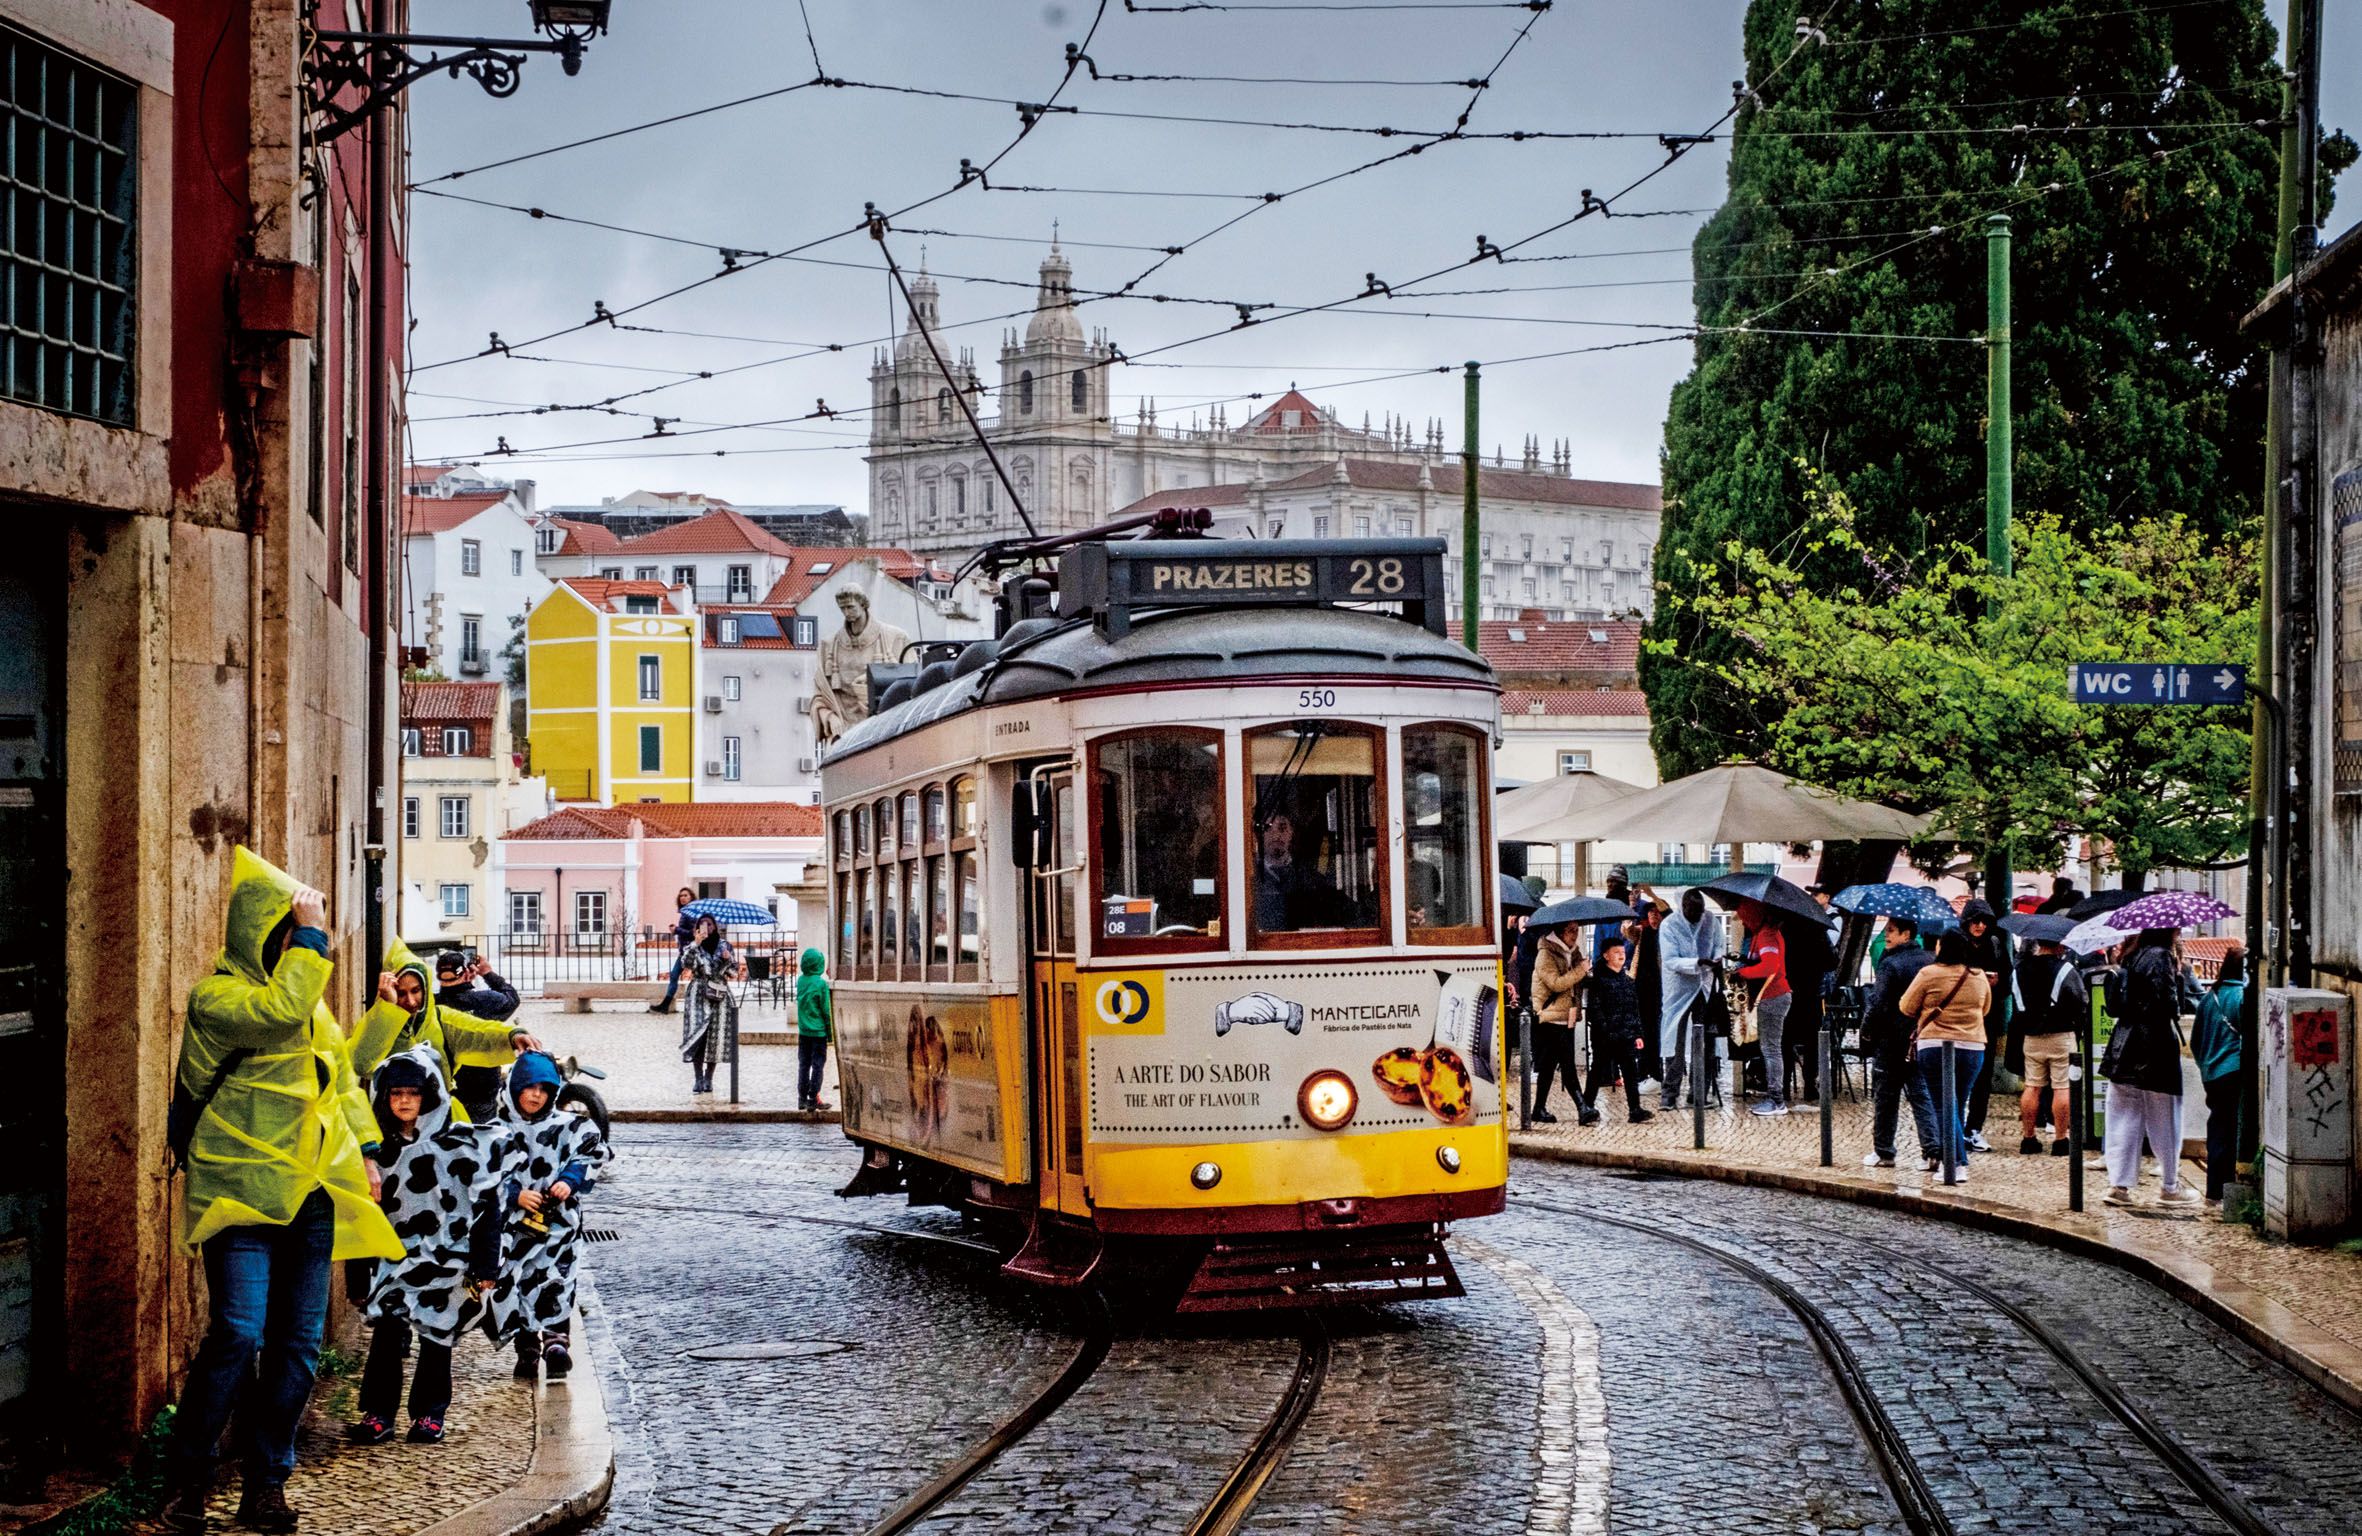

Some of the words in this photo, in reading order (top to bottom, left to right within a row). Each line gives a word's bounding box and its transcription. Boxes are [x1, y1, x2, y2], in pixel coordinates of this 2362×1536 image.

[1153, 562, 1313, 590] PRAZERES
[1350, 558, 1405, 594] 28
[2083, 672, 2132, 694] WC
[1299, 690, 1336, 708] 550
[995, 720, 1030, 737] ENTRADA
[1108, 906, 1125, 915] 28E
[1108, 922, 1126, 934] 08
[1311, 1004, 1421, 1021] MANTEIGARIA
[1387, 1022, 1396, 1030] de
[1115, 1065, 1125, 1084] A
[1130, 1065, 1174, 1084] ARTE
[1180, 1064, 1204, 1083] DO
[1210, 1063, 1271, 1083] SABOR
[1124, 1094, 1148, 1107] THE
[1151, 1094, 1175, 1107] ART
[1179, 1094, 1196, 1107] OF
[1200, 1092, 1260, 1107] FLAVOUR
